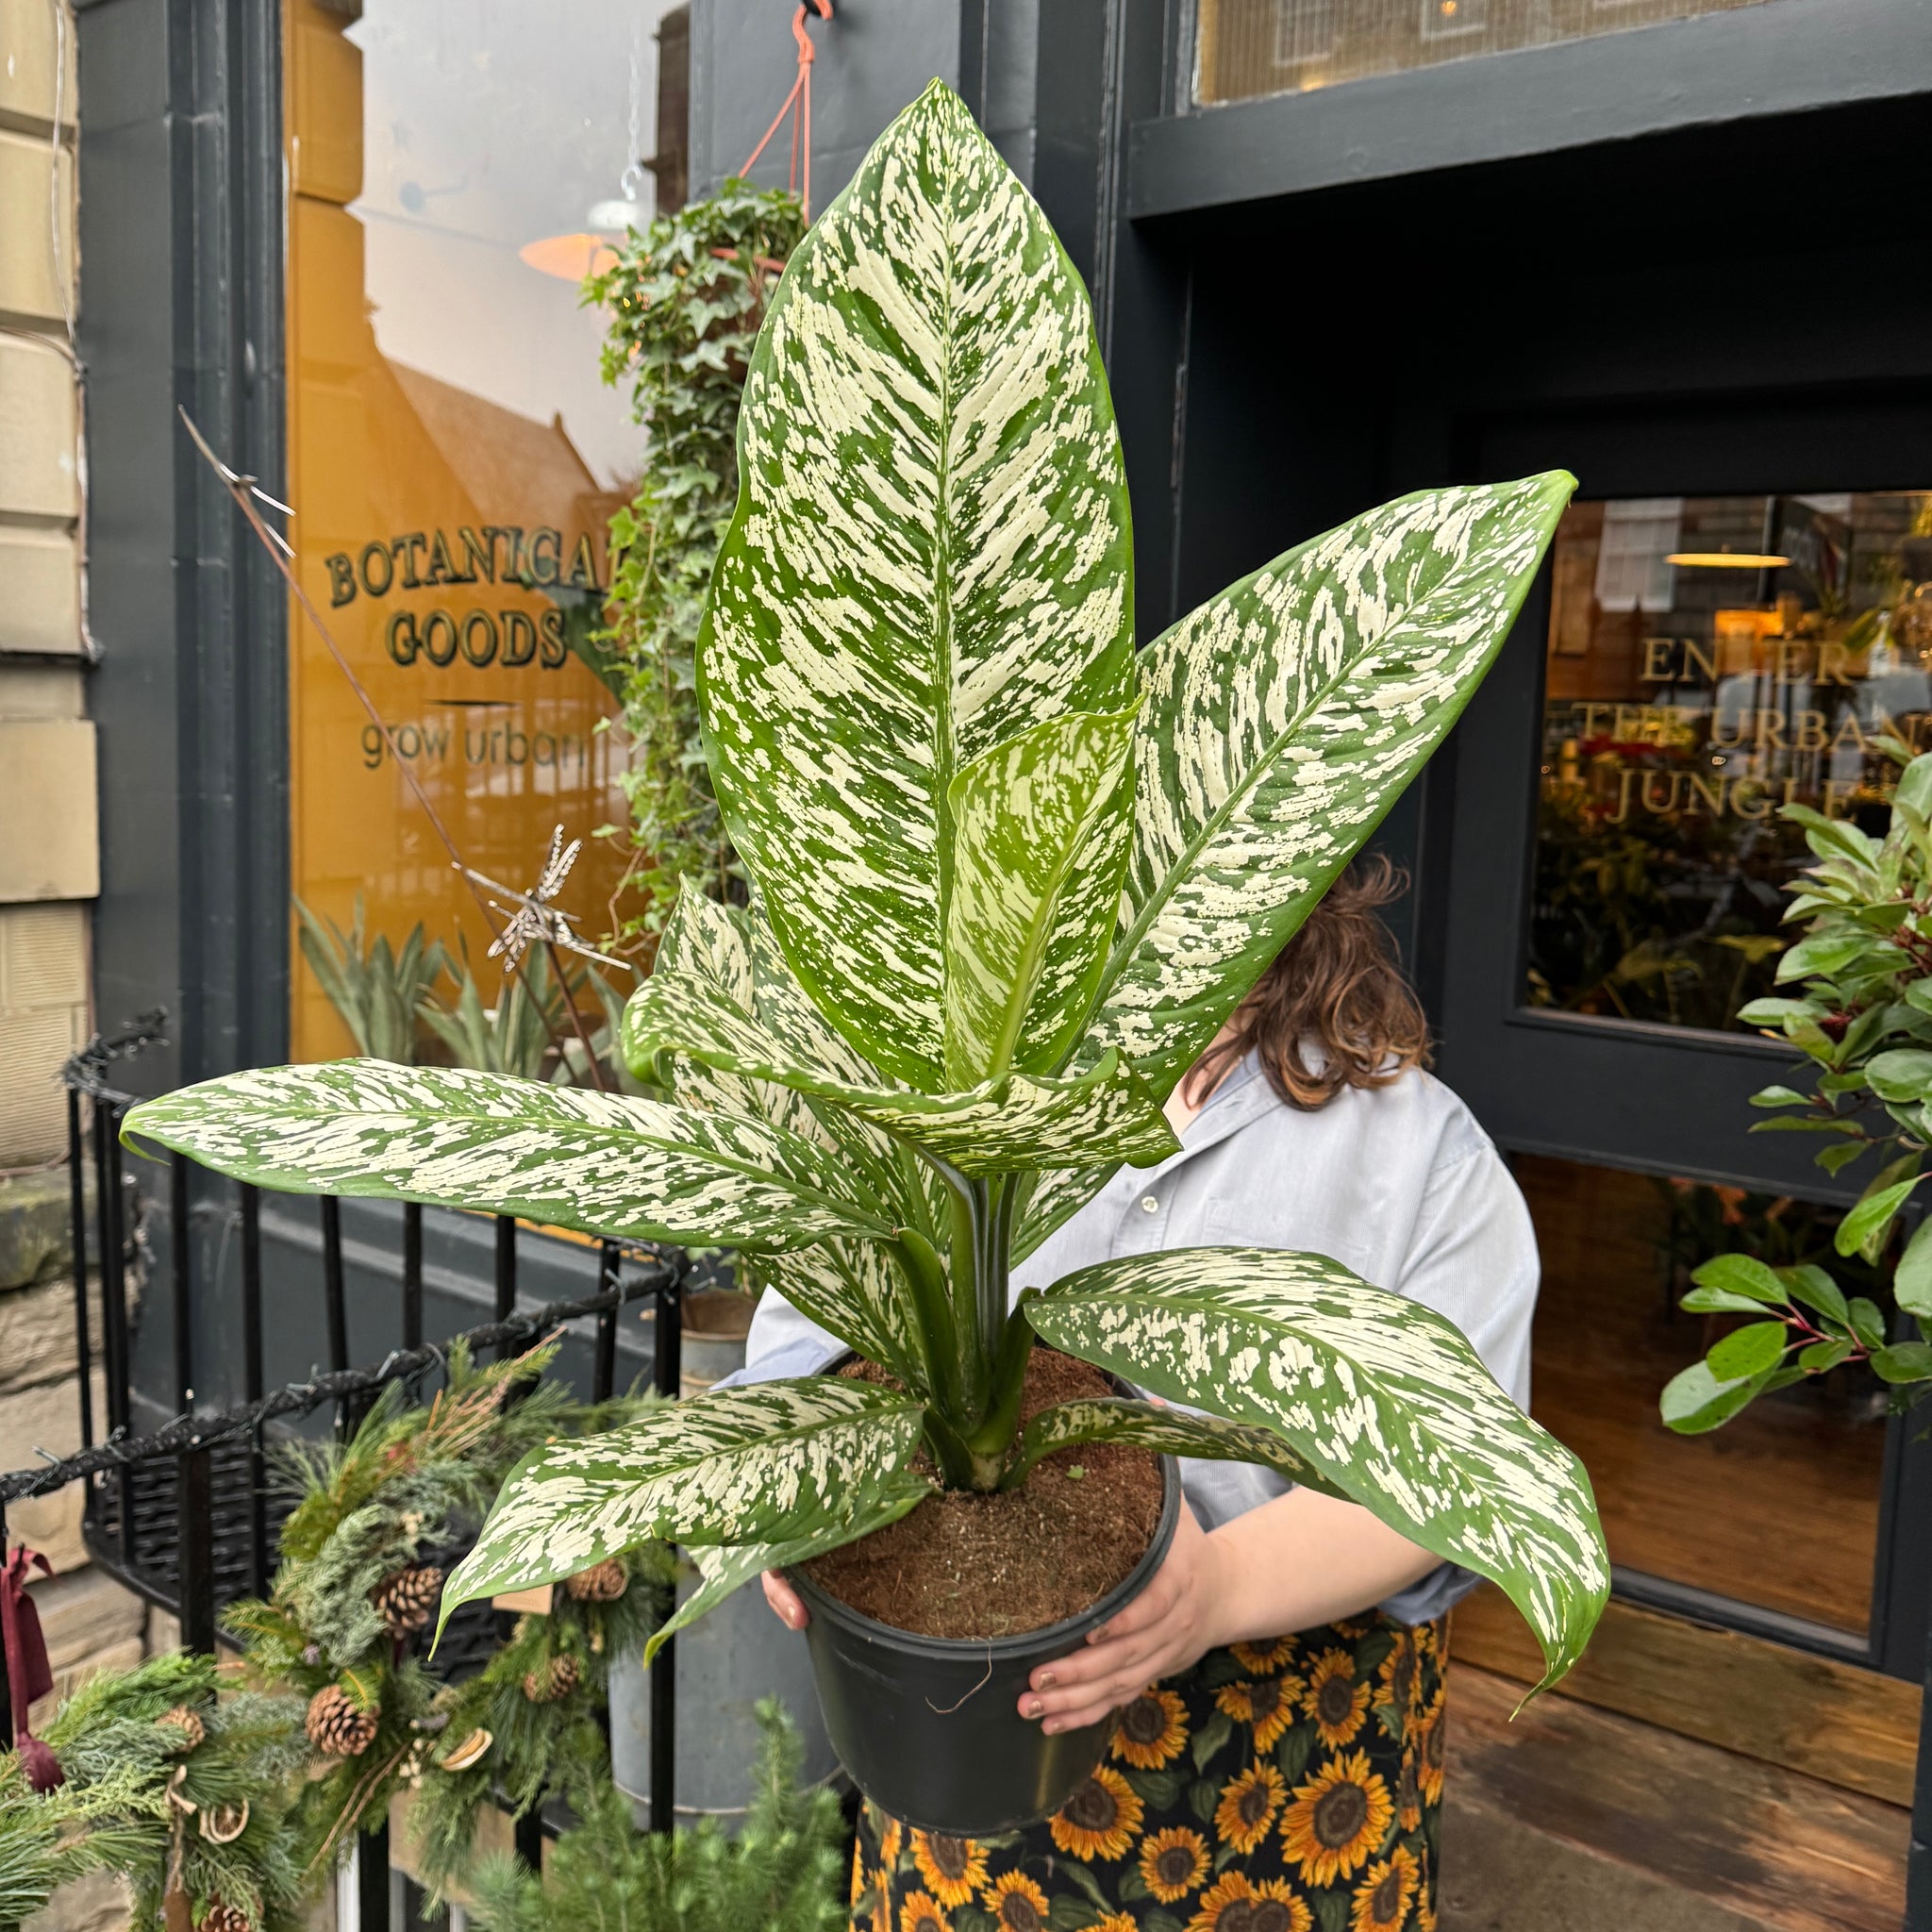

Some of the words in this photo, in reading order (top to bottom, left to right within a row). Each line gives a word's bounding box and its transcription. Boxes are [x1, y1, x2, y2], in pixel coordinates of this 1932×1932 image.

[385, 608, 568, 671] GOODS
[360, 722, 451, 769] grow
[464, 721, 584, 768] urban
[1571, 702, 1688, 745] THE
[1709, 708, 1924, 755] URBAN
